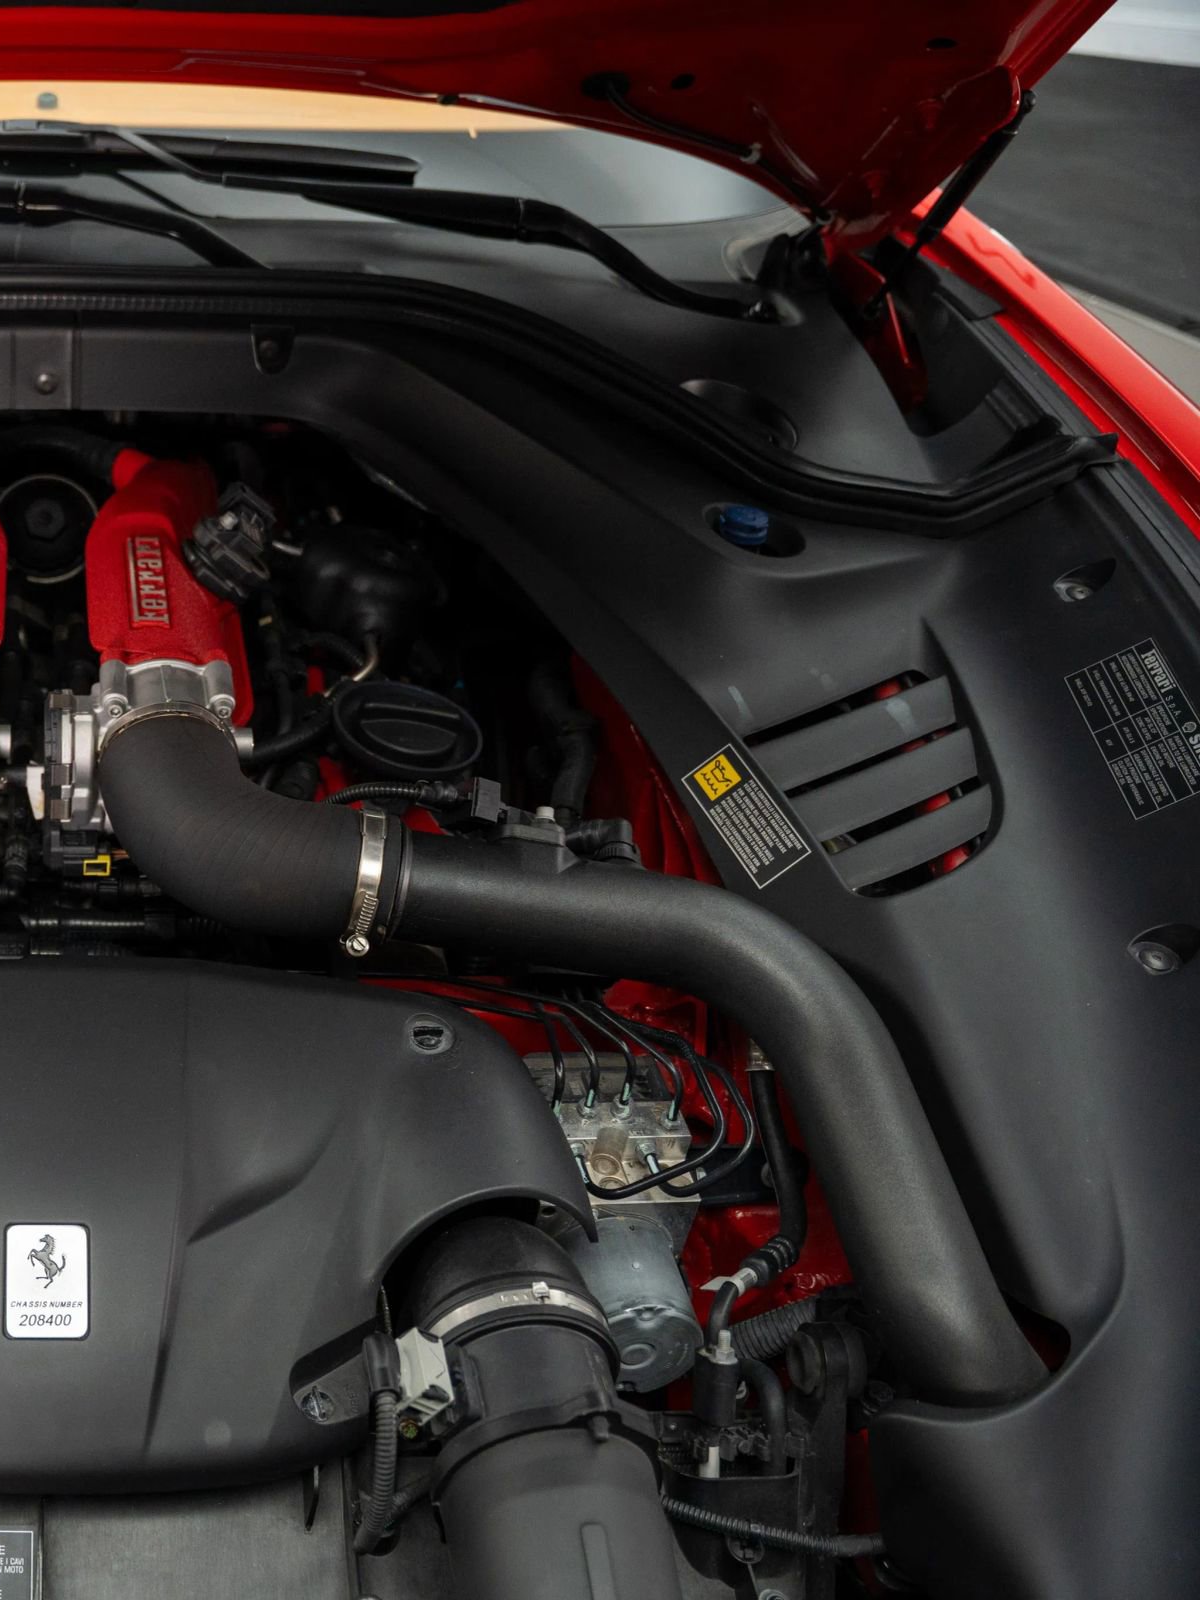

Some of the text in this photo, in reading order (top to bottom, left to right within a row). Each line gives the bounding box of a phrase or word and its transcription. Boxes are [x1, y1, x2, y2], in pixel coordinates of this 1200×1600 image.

[127, 536, 169, 624] Ferrari
[1141, 648, 1175, 692] Ferrari
[19, 1314, 72, 1326] 208400
[10, 1558, 24, 1566] CAVI
[4, 1566, 23, 1574] MOTO
